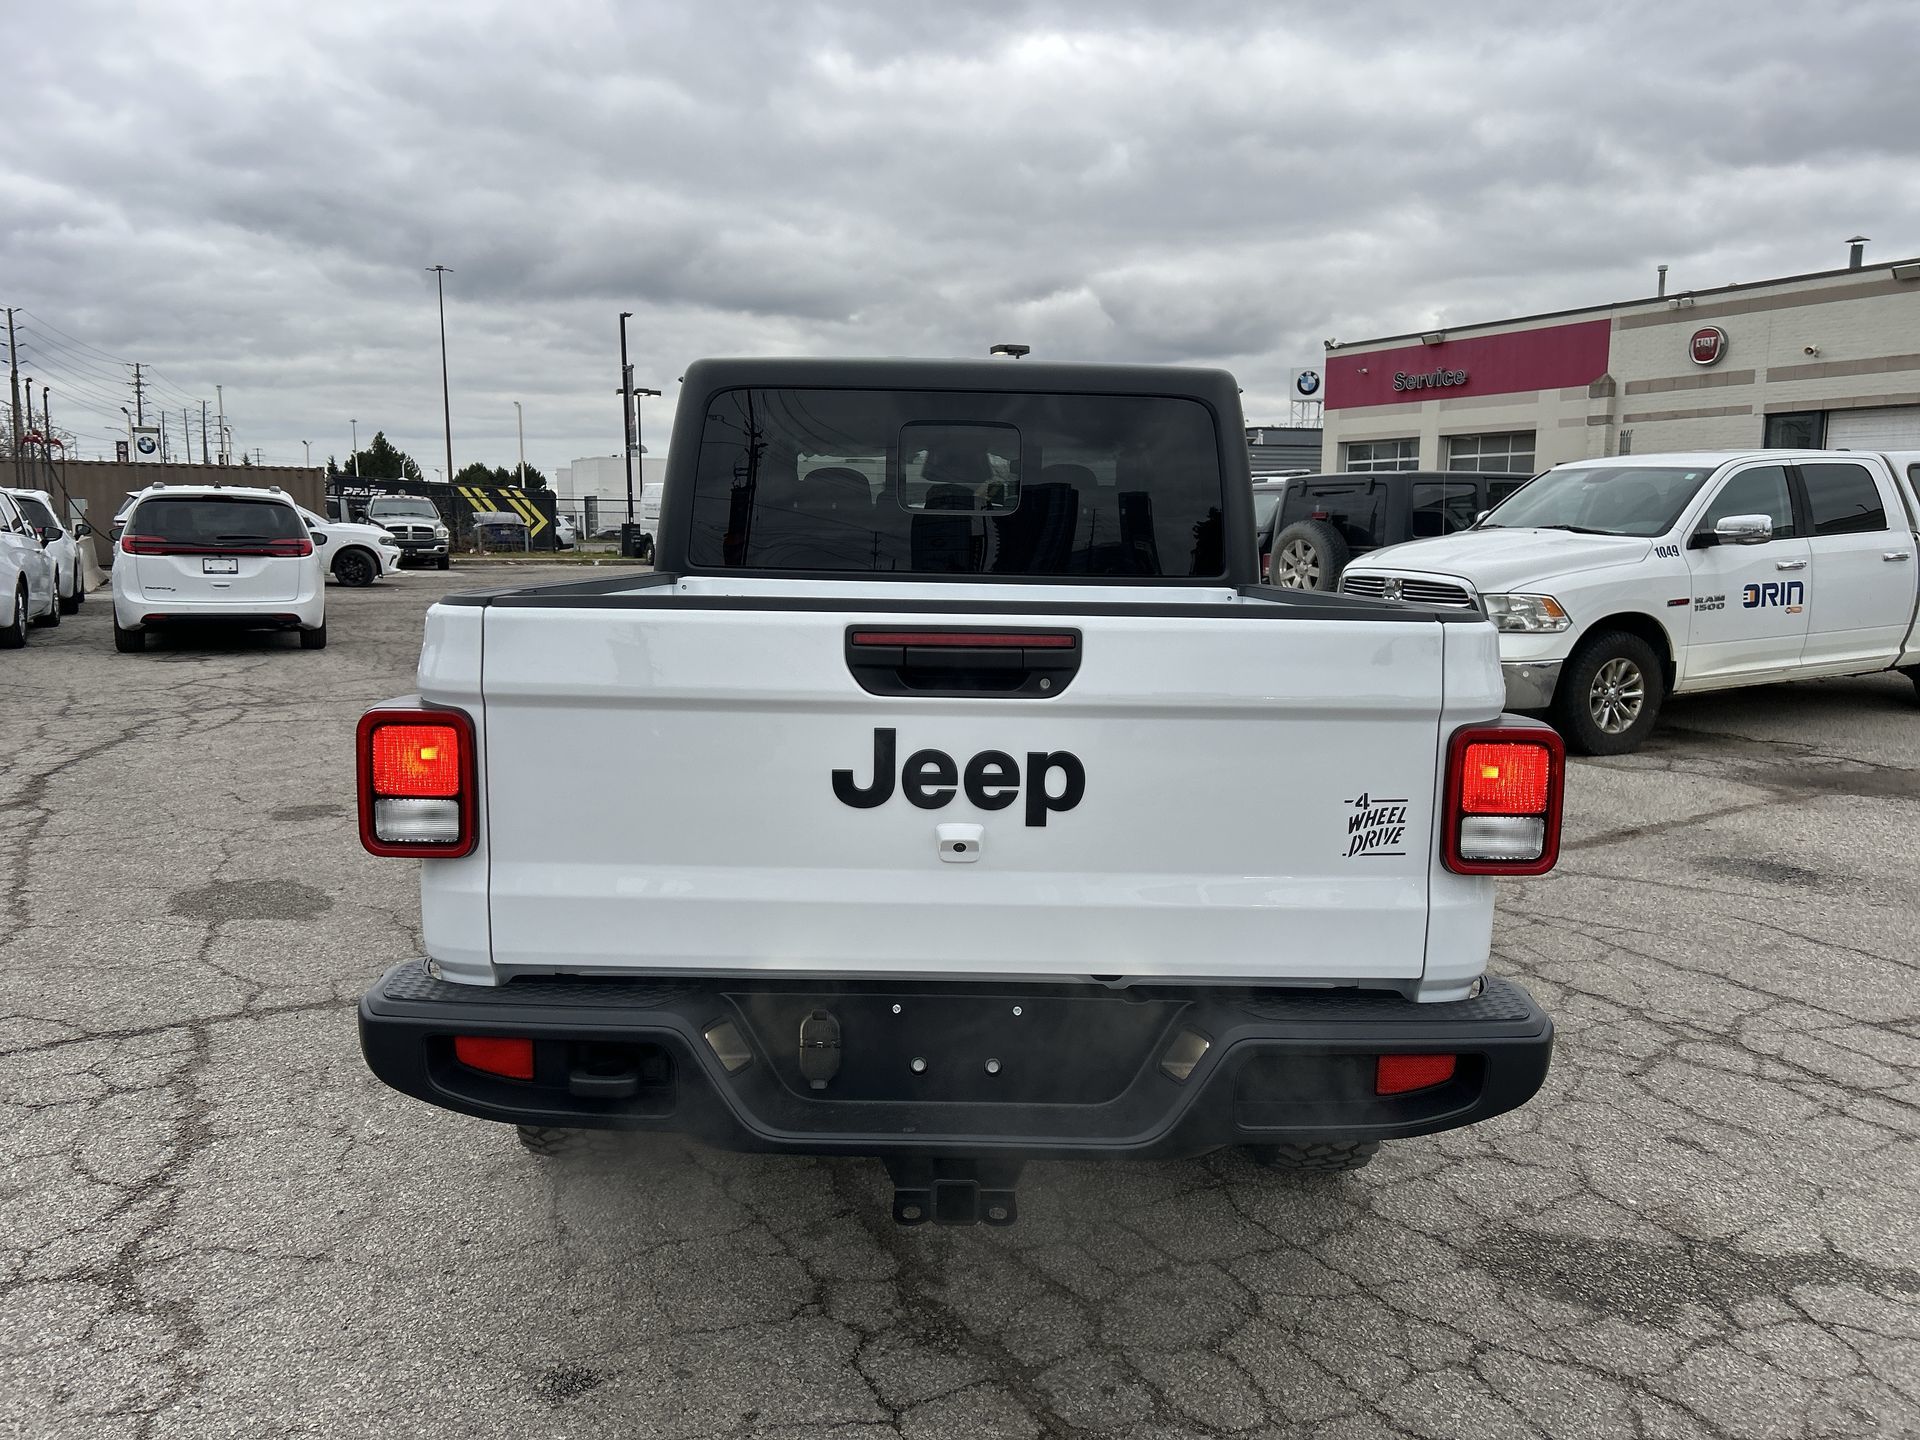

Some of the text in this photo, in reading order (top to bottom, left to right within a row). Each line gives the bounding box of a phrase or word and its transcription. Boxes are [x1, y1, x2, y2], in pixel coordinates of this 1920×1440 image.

[1393, 367, 1467, 392] Service
[343, 486, 387, 496] PFAFF
[1654, 544, 1680, 559] 1049
[1694, 594, 1726, 604] RAM
[1694, 602, 1725, 612] 1500
[832, 727, 1086, 827] Jeep
[1355, 792, 1370, 810] 4
[1348, 806, 1407, 835] WHEEL
[1347, 826, 1406, 858] DRIVE
